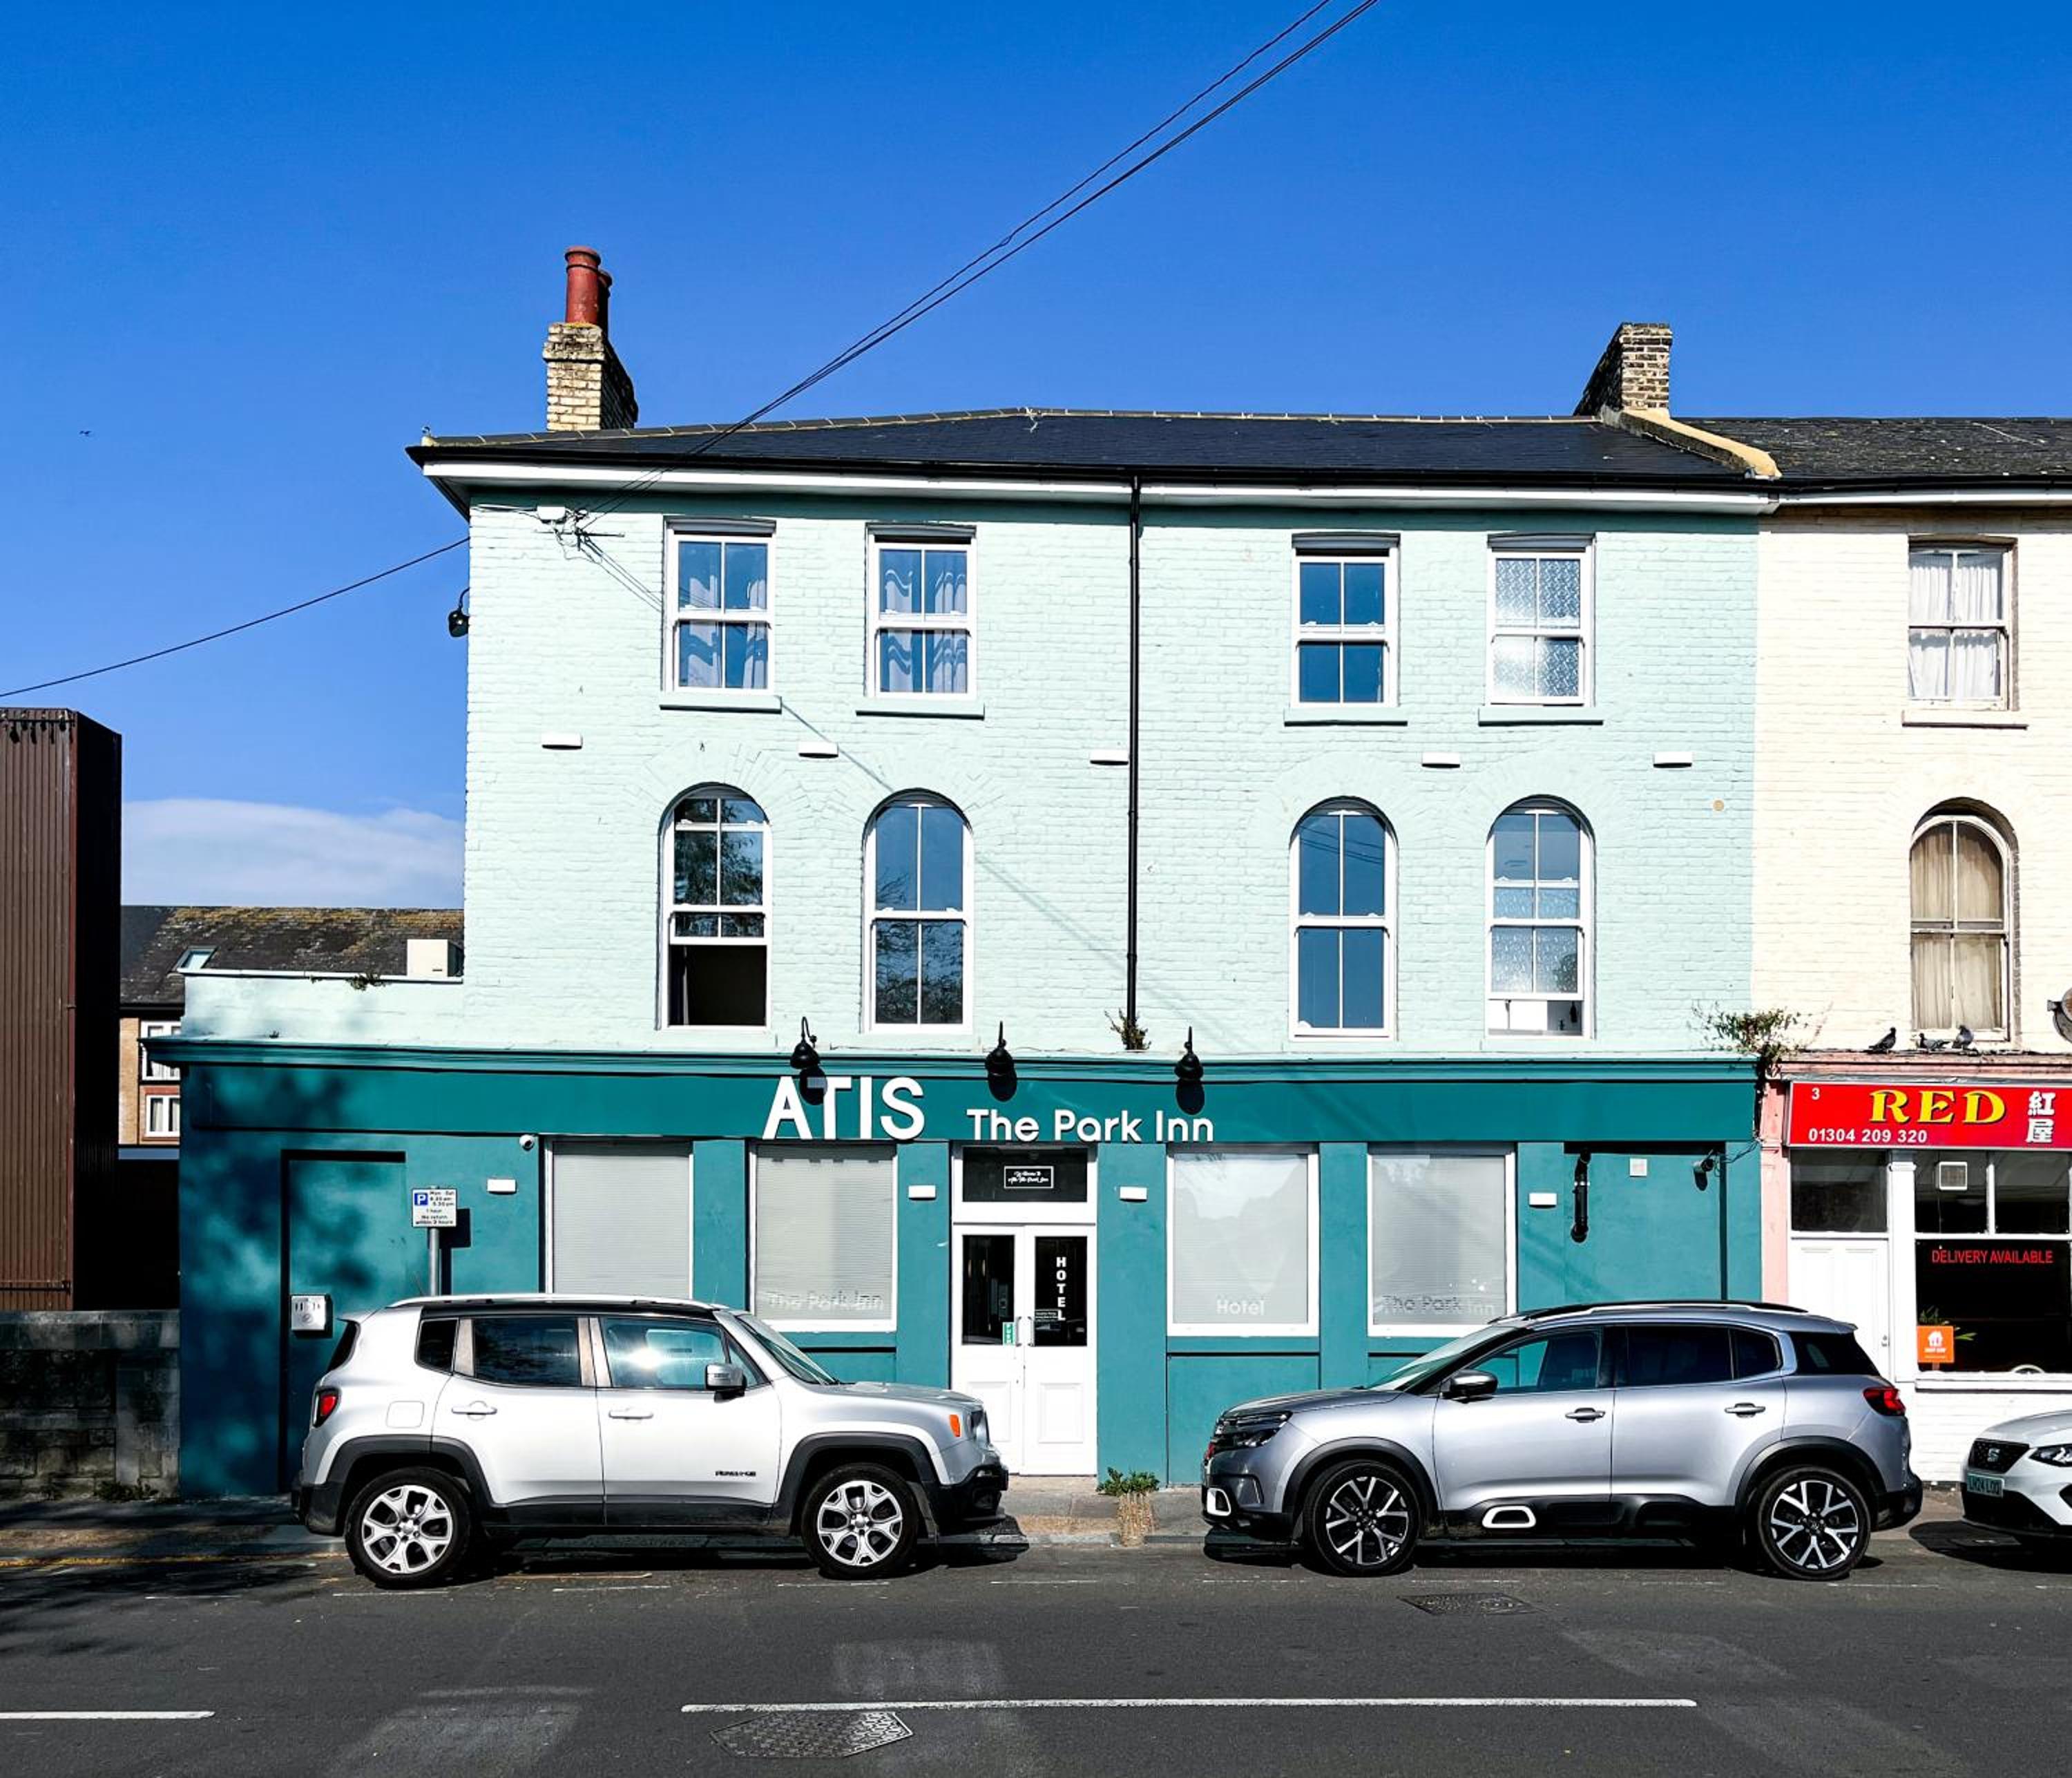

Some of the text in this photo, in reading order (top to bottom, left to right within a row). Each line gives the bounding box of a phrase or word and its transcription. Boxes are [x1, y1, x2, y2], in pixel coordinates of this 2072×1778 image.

[1812, 1088, 1821, 1100] 3
[762, 1076, 925, 1140] ATIS
[1870, 1089, 2006, 1124] RED
[966, 1109, 1214, 1142] The Park Inn
[2026, 1091, 2056, 1143] 紅屋
[1808, 1128, 1927, 1143] 01304 209 320
[417, 1194, 426, 1205] P
[1932, 1250, 2053, 1264] DELIVERY AVAILABLE
[1056, 1256, 1067, 1321] HOTEL
[1216, 1299, 1265, 1316] Hotel
[1421, 1295, 1462, 1314] Park
